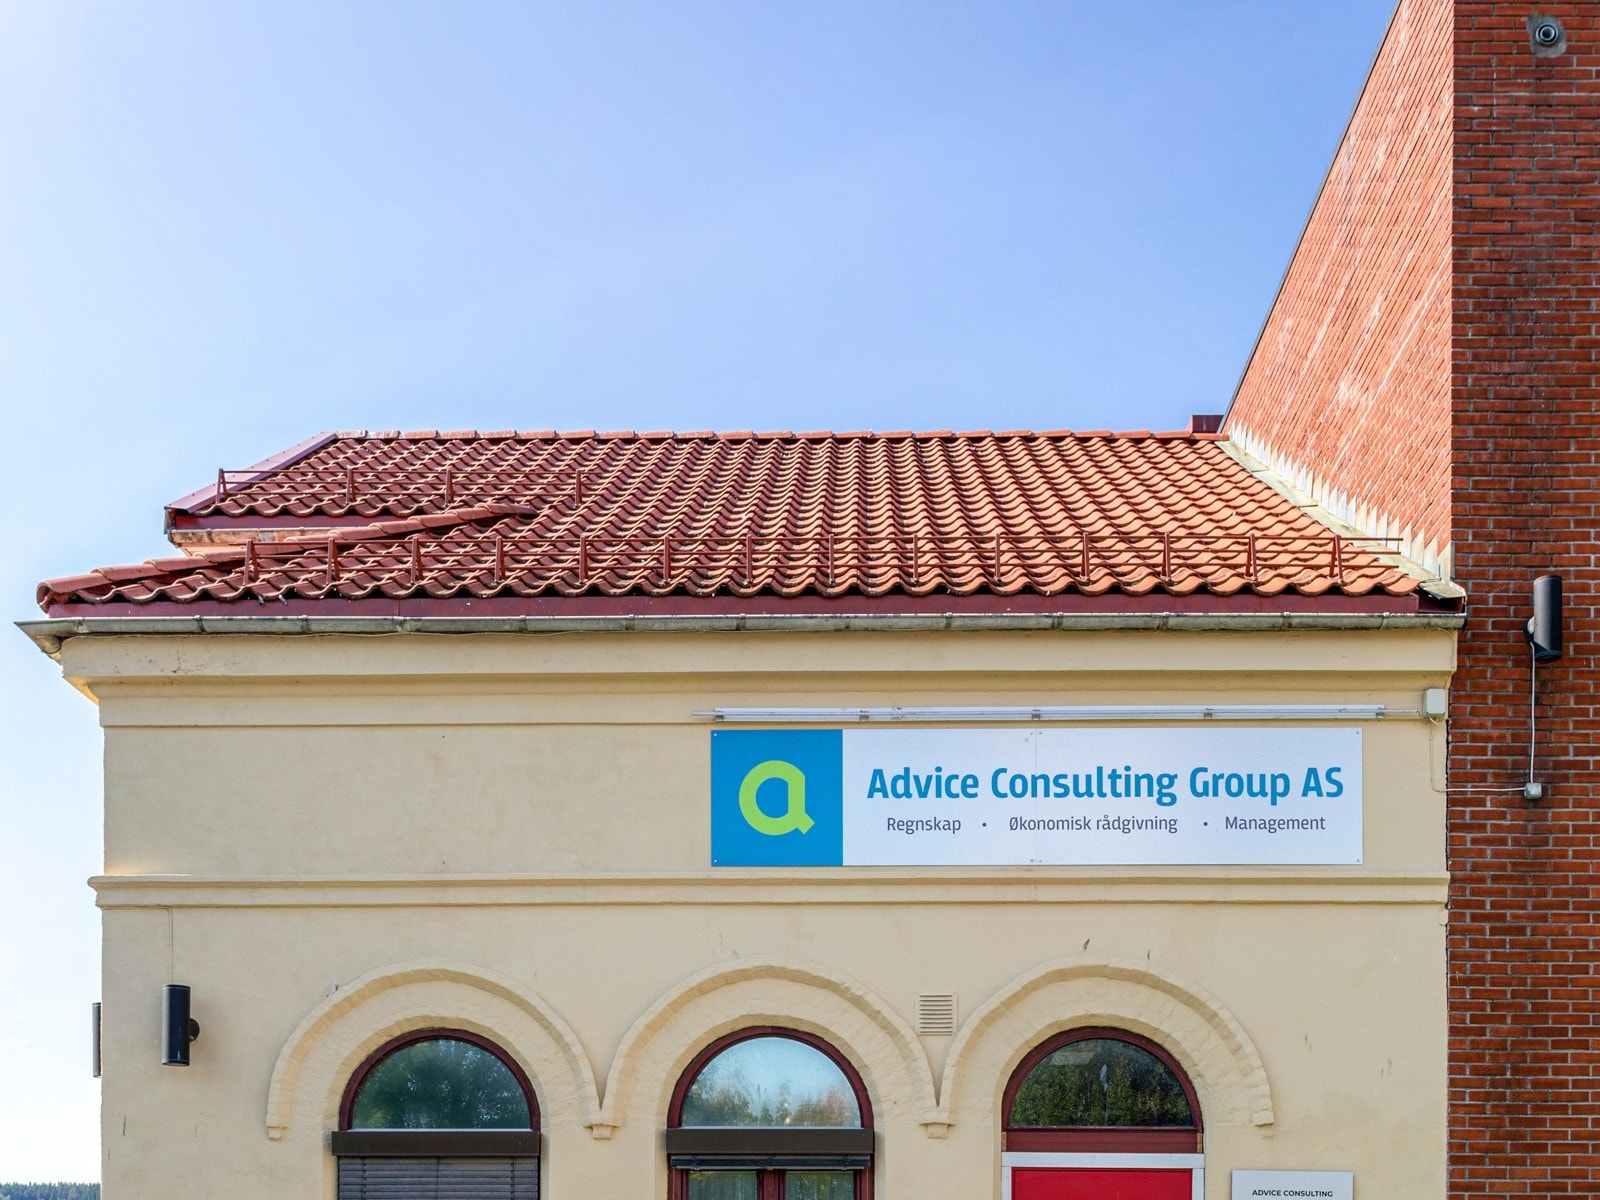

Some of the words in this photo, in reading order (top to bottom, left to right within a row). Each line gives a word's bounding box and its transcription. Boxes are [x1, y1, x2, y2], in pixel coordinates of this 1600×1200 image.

[866, 765, 980, 800] Advice
[990, 765, 1178, 807] Consulting
[1189, 766, 1291, 807] Group
[1301, 766, 1344, 798] AS
[887, 816, 962, 835] Regnskap
[1009, 815, 1092, 832] Økonomisk
[1096, 814, 1179, 834] rådgivning
[1225, 816, 1326, 834] Management
[1251, 1189, 1282, 1197] ADVICE
[1283, 1189, 1333, 1198] CONSULTING
